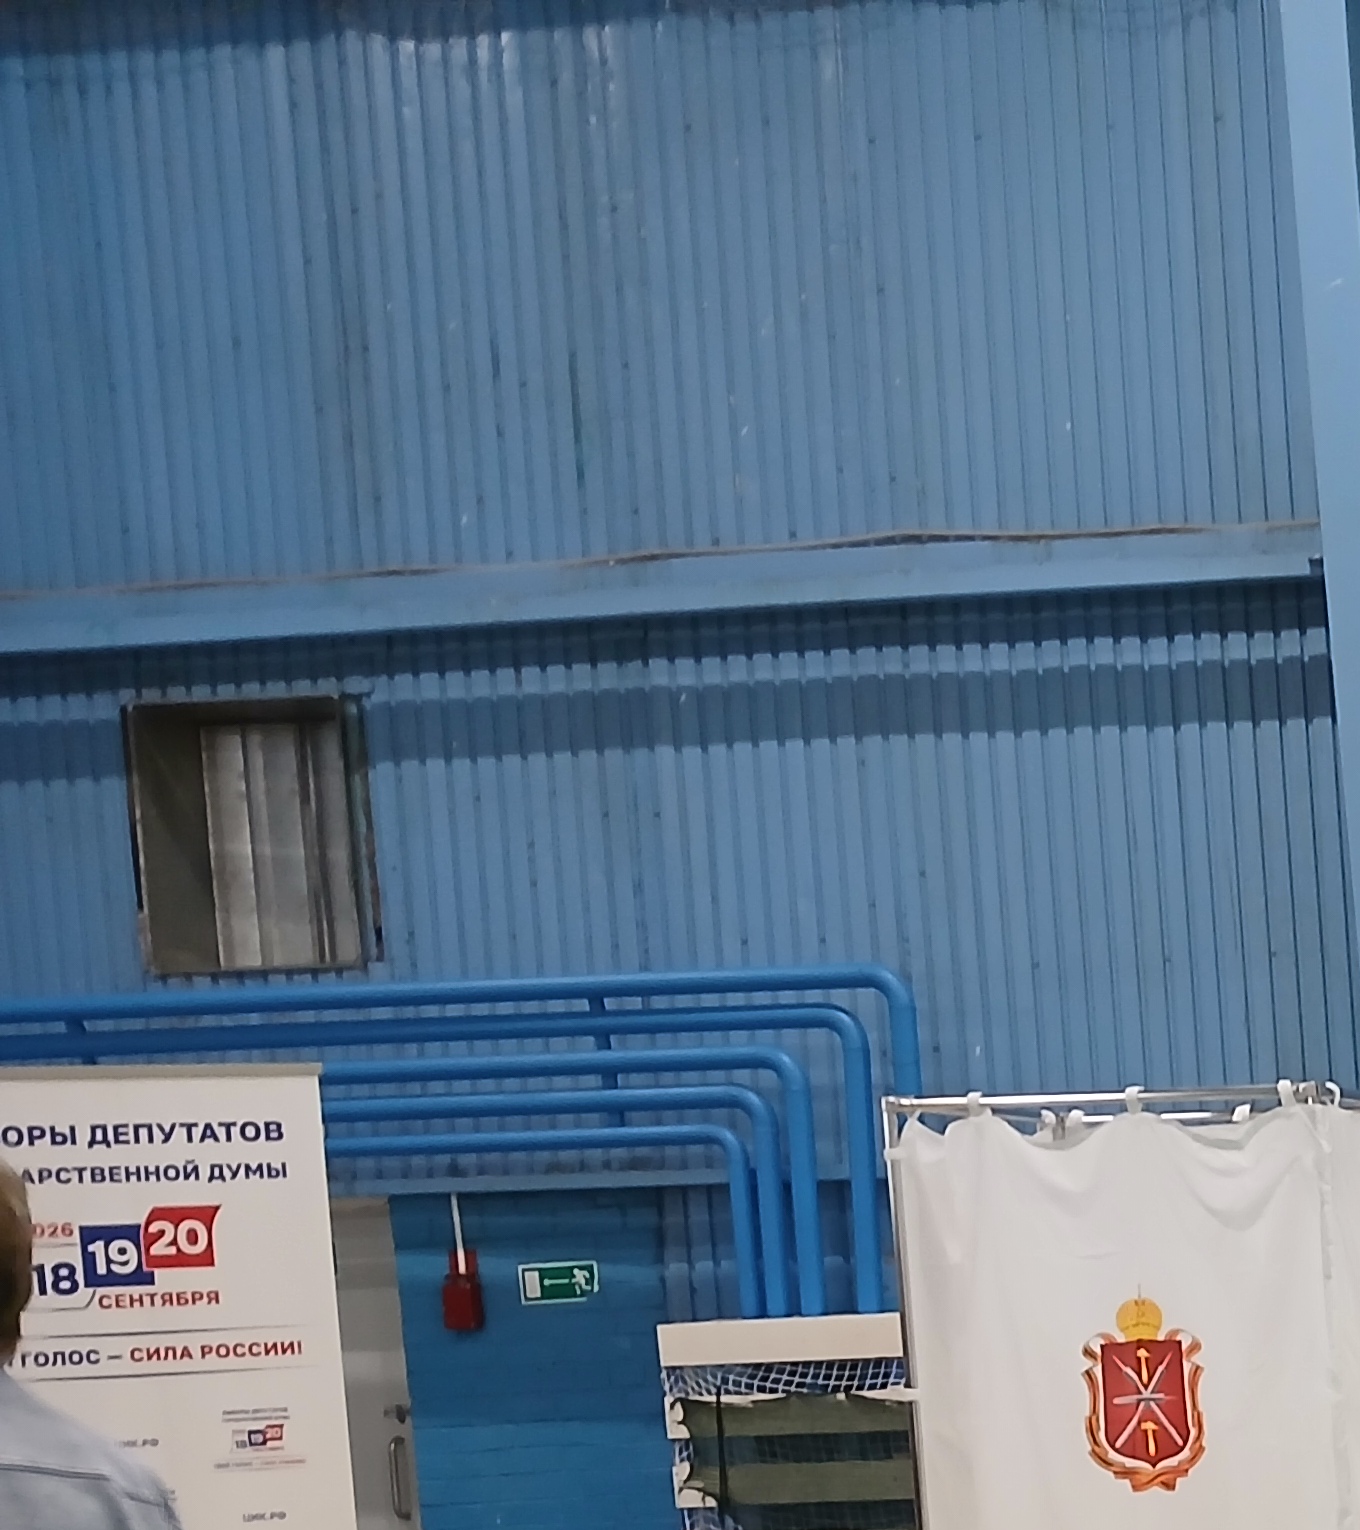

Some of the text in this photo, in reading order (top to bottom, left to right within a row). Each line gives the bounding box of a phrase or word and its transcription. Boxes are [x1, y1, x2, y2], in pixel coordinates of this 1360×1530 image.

[0, 1121, 285, 1149] ОРЫ ДЕПУТАТОВ
[20, 1158, 288, 1185] АРСТВЕННОЙ ДУМЫ
[32, 1222, 74, 1239] 026
[147, 1218, 209, 1255] 20
[87, 1238, 139, 1276] 19
[32, 1261, 80, 1296] 18
[98, 1290, 221, 1309] СЕНТЯБРЯ
[20, 1348, 101, 1368] ГОЛОС
[129, 1344, 194, 1362] СИЛА
